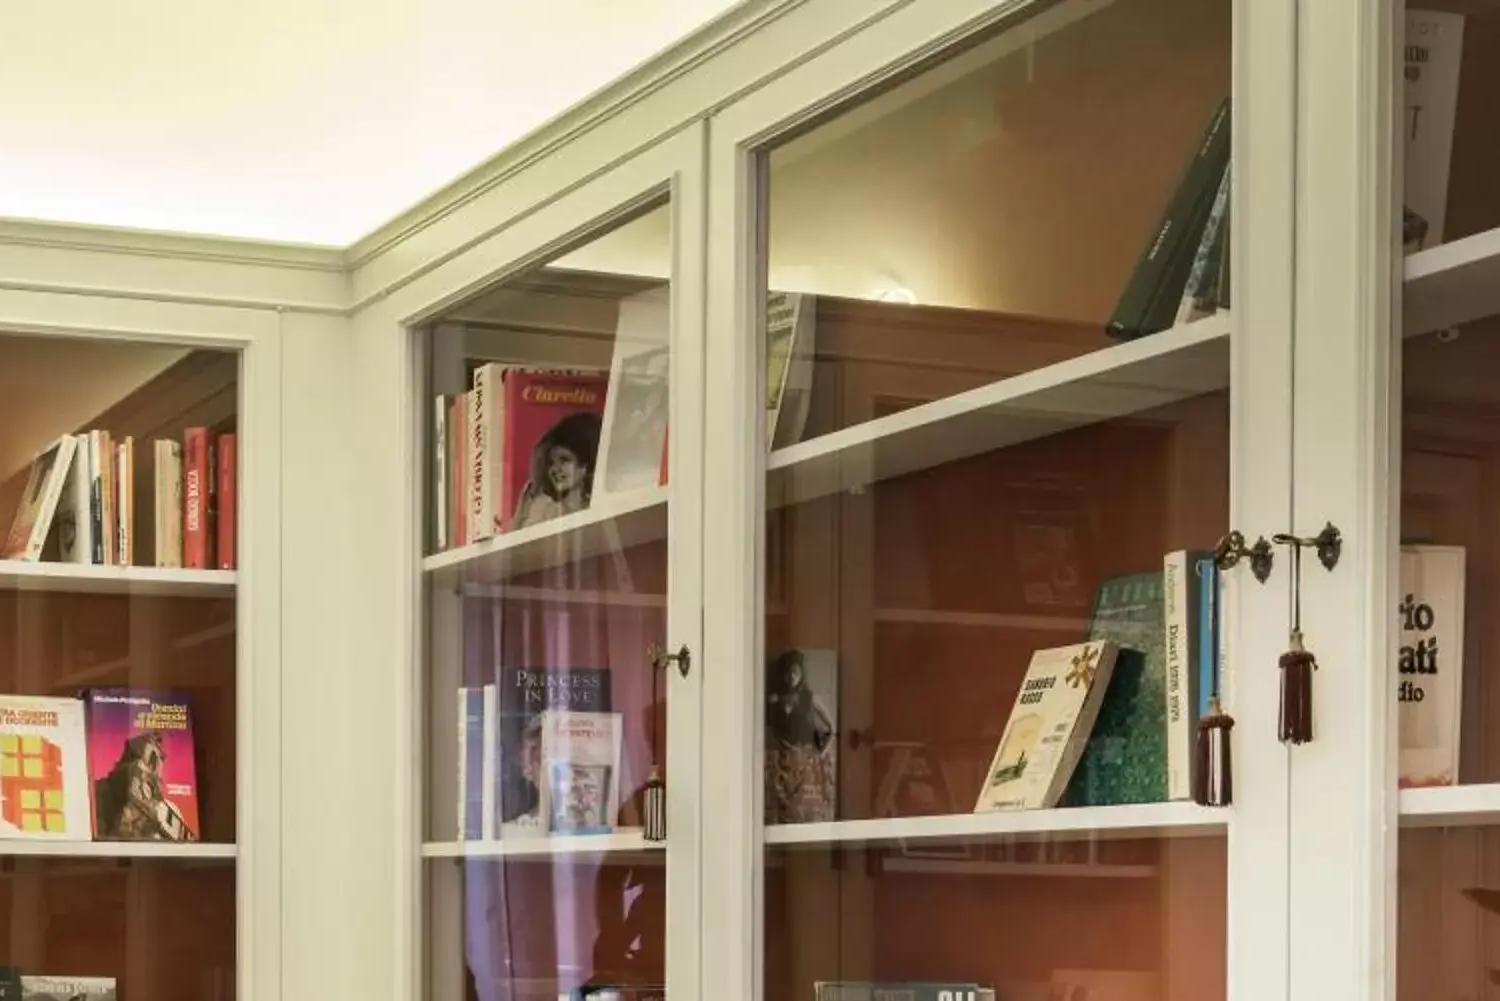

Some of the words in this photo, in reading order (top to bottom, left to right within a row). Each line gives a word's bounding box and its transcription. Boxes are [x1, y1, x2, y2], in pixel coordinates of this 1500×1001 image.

[516, 671, 600, 688] PRINCESS
[525, 688, 541, 702] IN
[547, 687, 592, 703] LOVE
